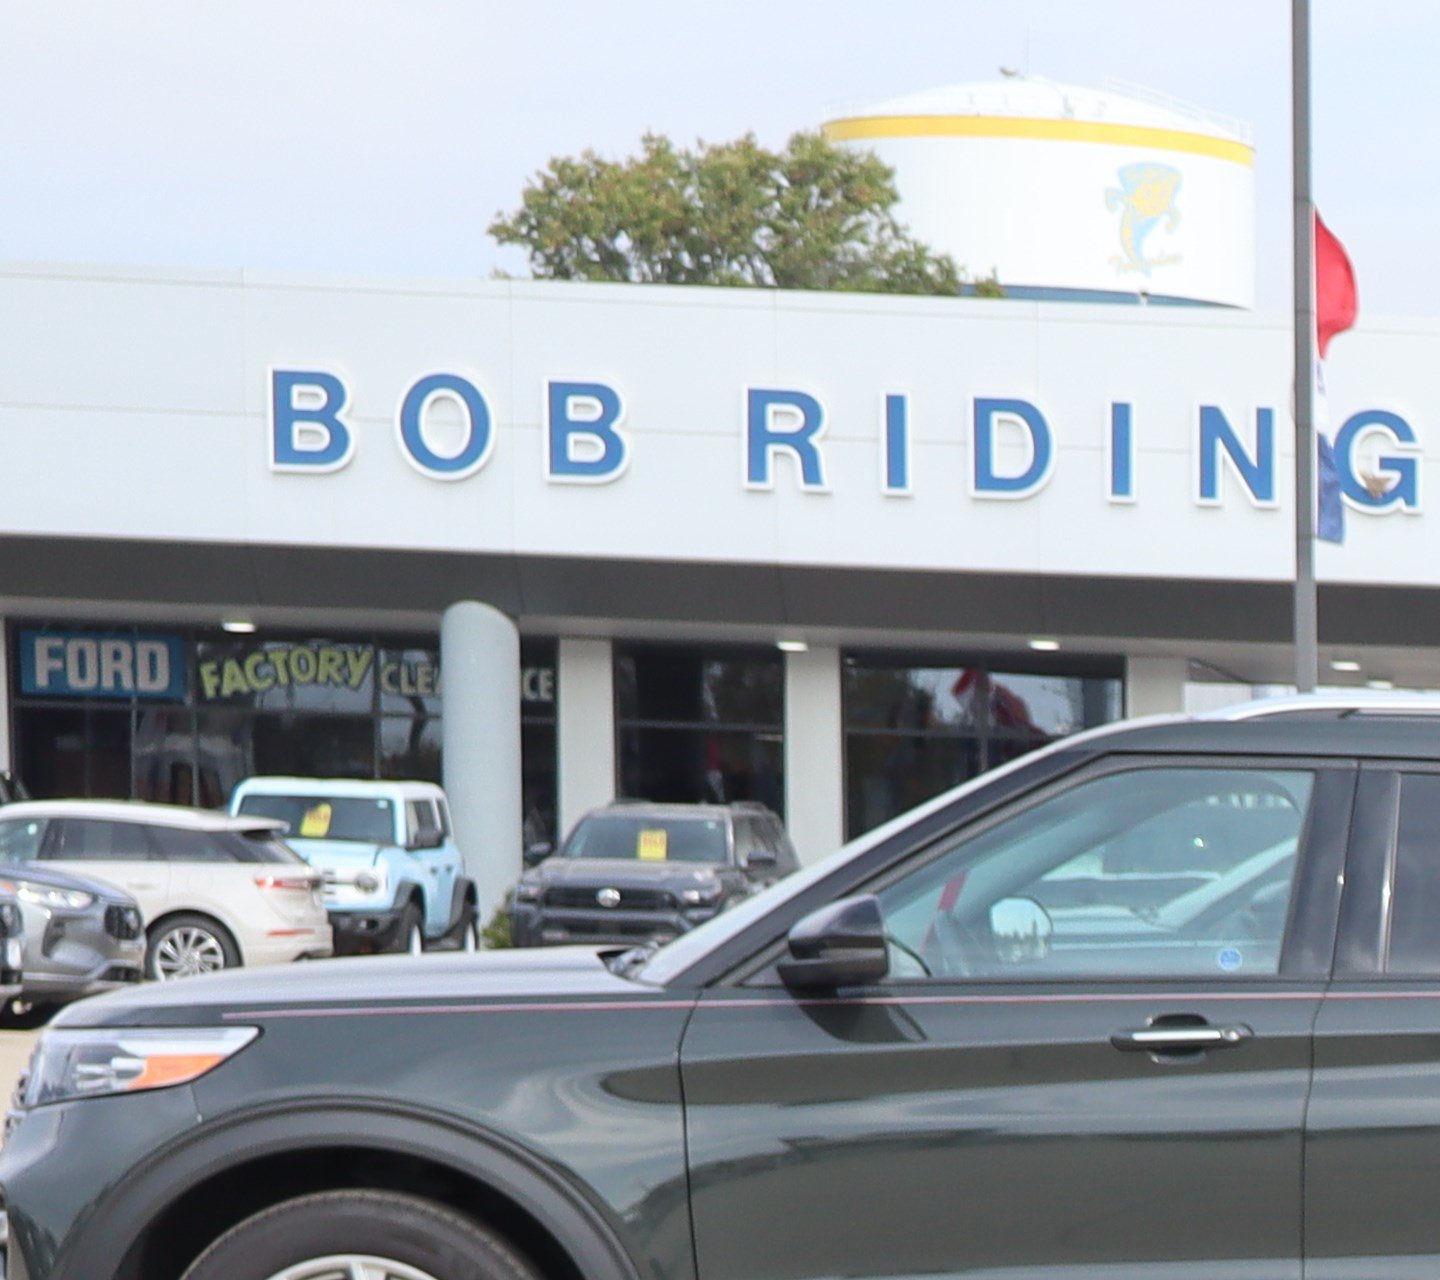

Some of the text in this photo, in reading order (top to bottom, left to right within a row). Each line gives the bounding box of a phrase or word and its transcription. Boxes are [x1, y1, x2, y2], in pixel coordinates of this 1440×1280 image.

[270, 368, 630, 476] BOB
[34, 637, 170, 692] FORD
[200, 645, 372, 698] FACTORY
